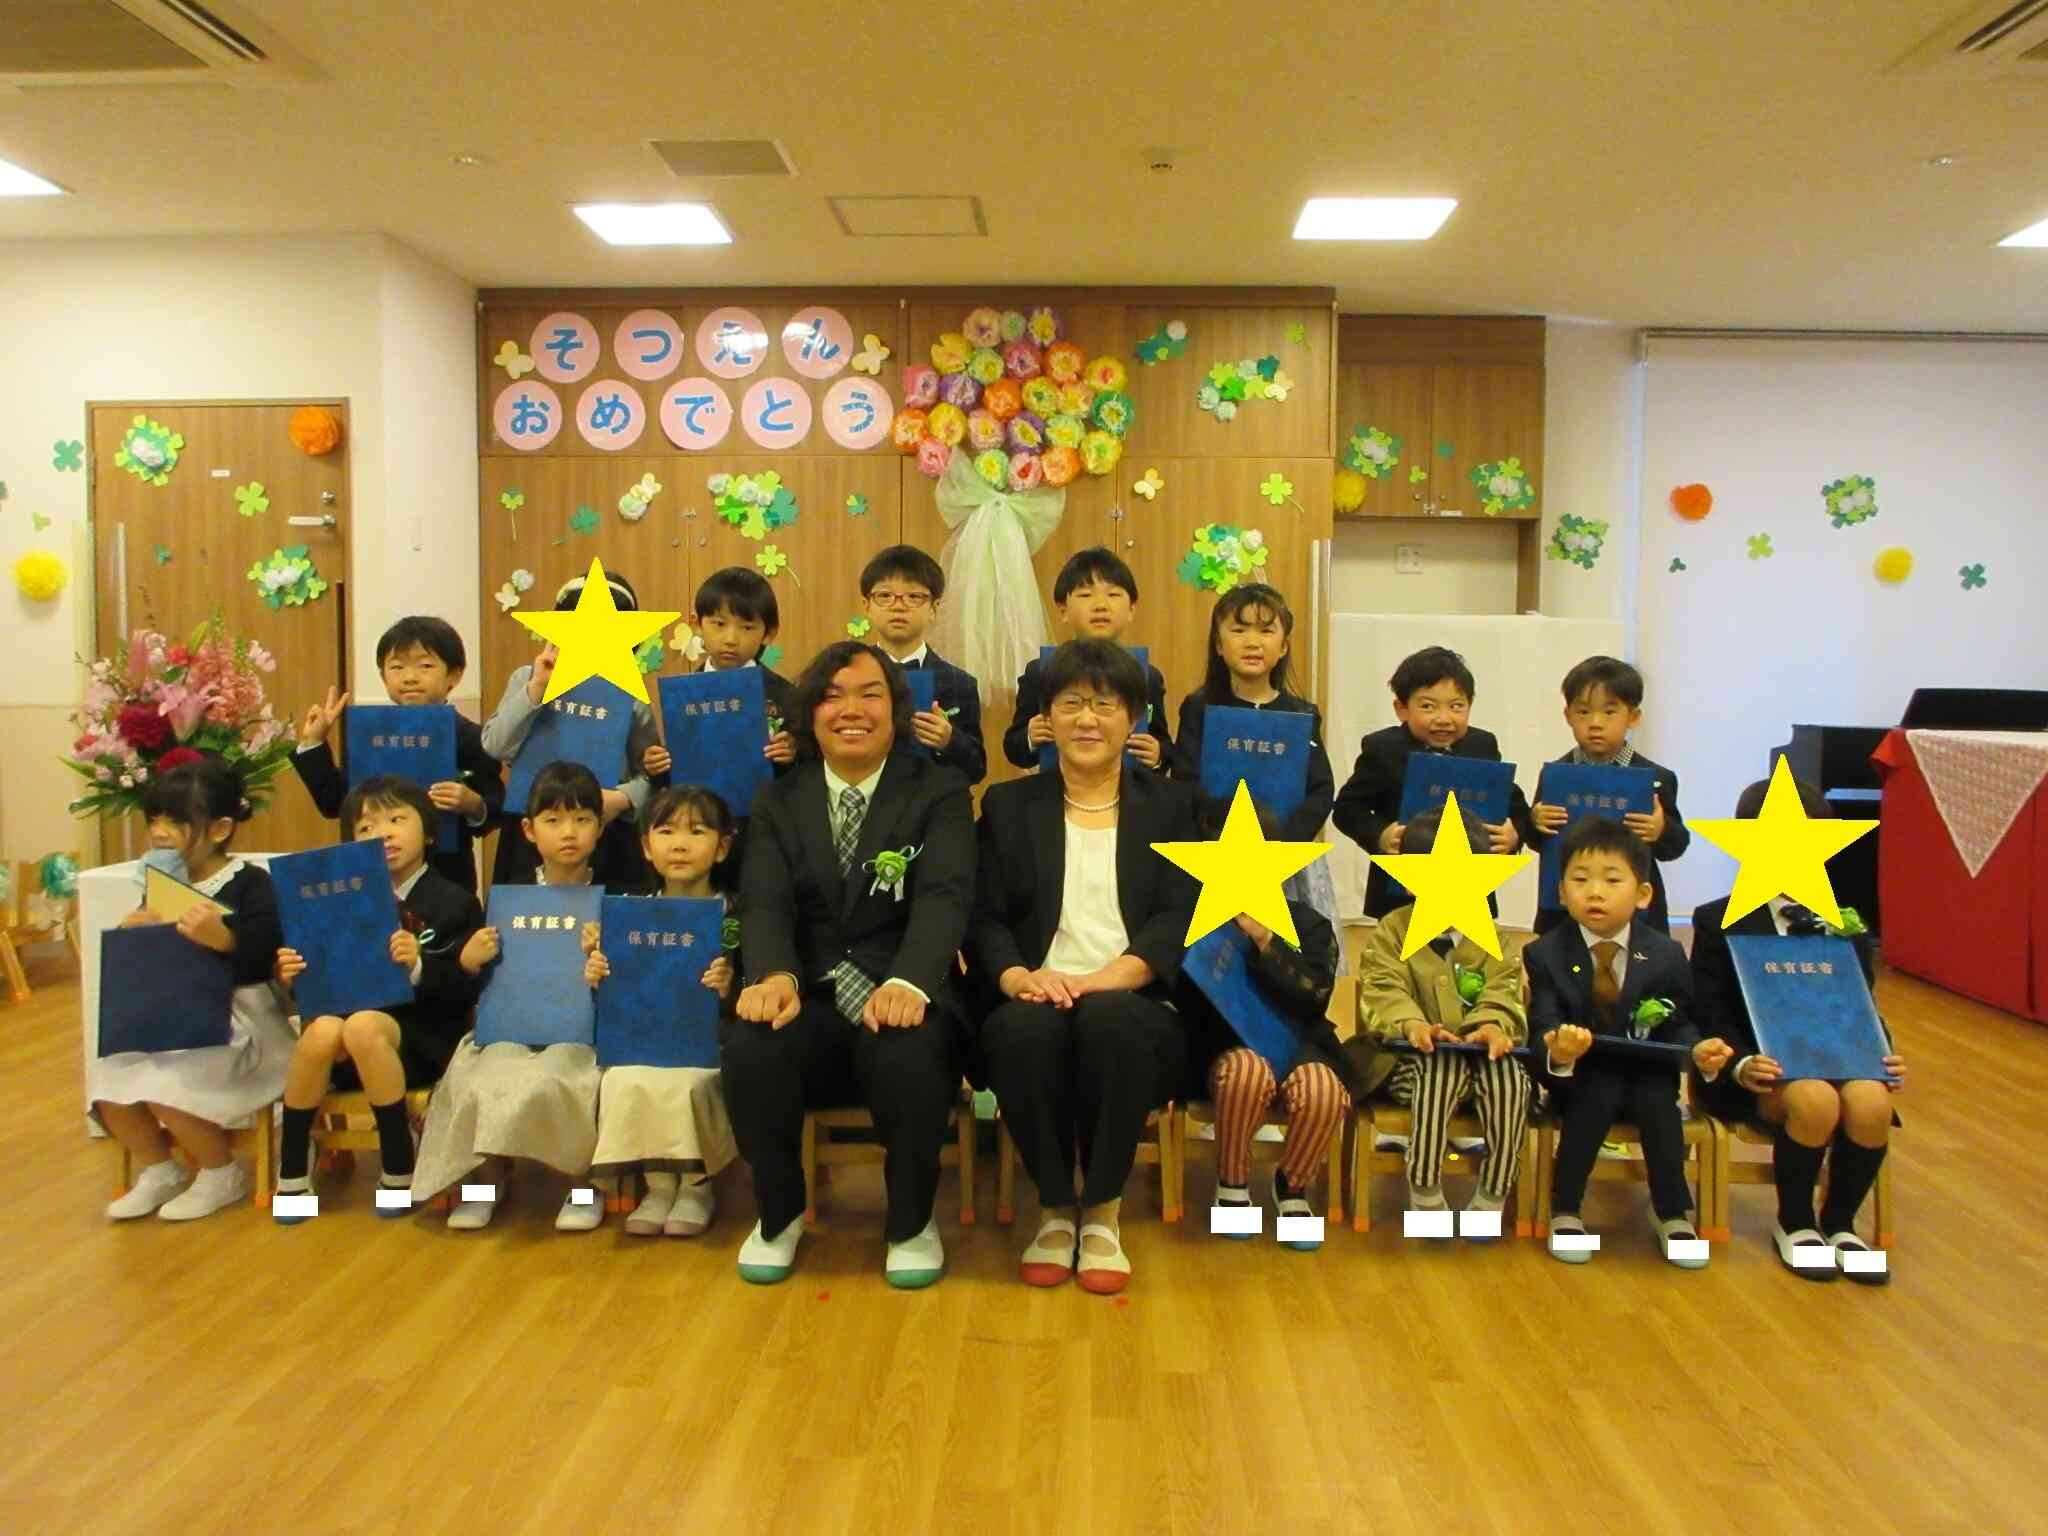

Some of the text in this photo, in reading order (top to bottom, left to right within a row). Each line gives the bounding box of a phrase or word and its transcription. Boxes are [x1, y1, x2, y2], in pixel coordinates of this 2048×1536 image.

[545, 316, 841, 370] そつえん
[511, 389, 876, 435] おめでとう
[685, 698, 741, 716] 保育証書
[372, 735, 430, 750] 保育証書
[1225, 737, 1287, 756] 保育証書
[512, 914, 576, 930] 保育証書
[628, 930, 695, 949] 保育証書
[1764, 961, 1833, 975] 保育証書
